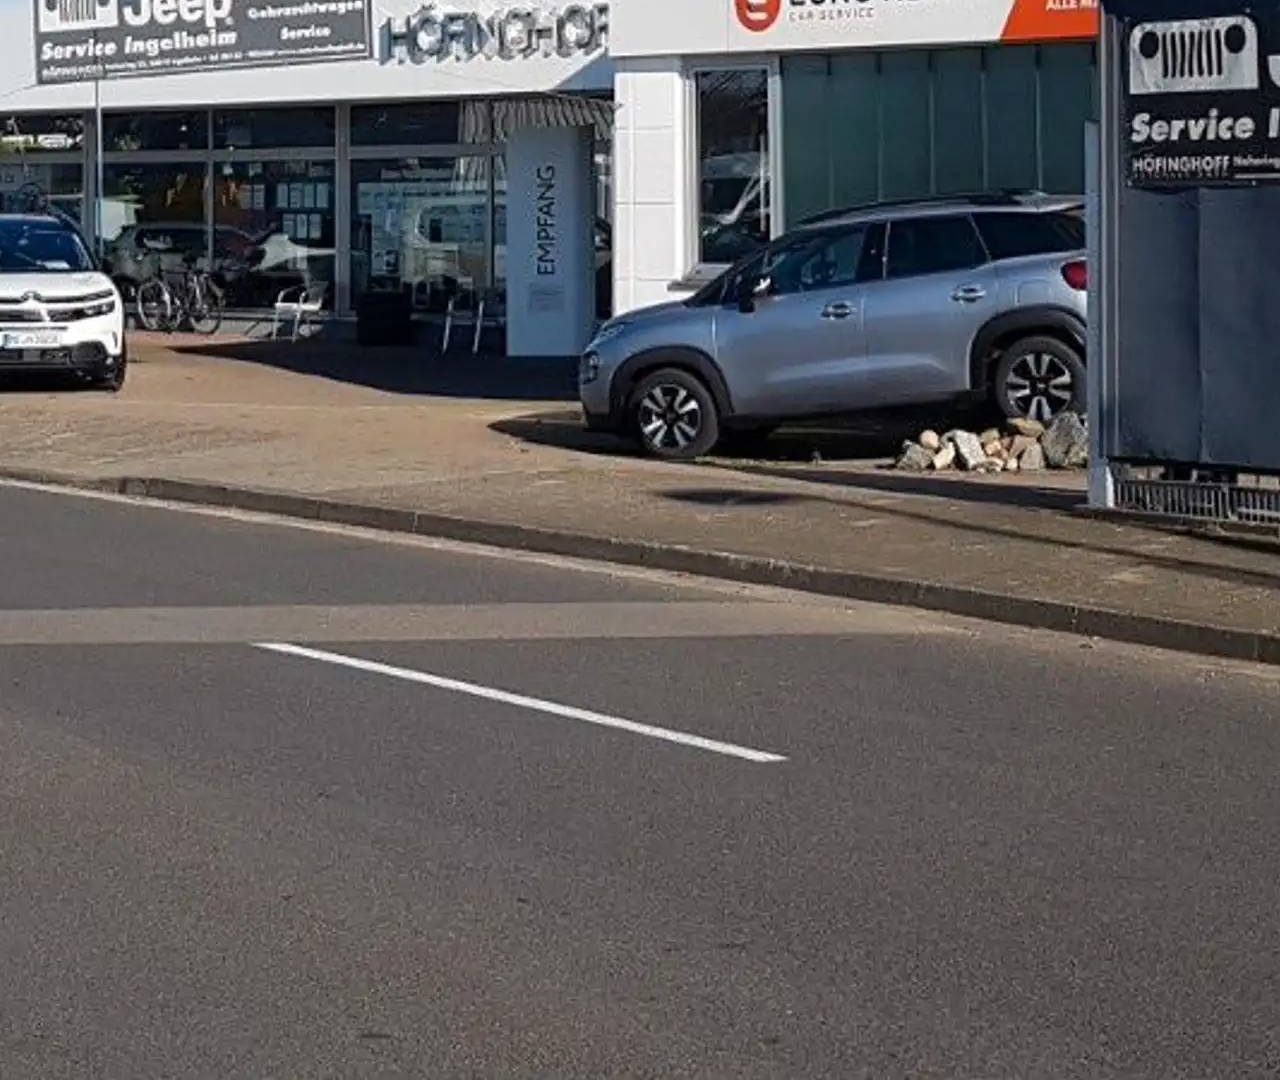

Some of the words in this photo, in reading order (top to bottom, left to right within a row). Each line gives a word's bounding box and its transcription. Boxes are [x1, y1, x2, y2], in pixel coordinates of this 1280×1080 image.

[820, 7, 875, 20] SERVICE
[40, 39, 117, 60] Service
[124, 29, 237, 56] Ingelheim
[1131, 108, 1255, 142] Service
[1132, 153, 1229, 172] HÖFINGHOFF
[536, 164, 556, 276] EMPFANG
